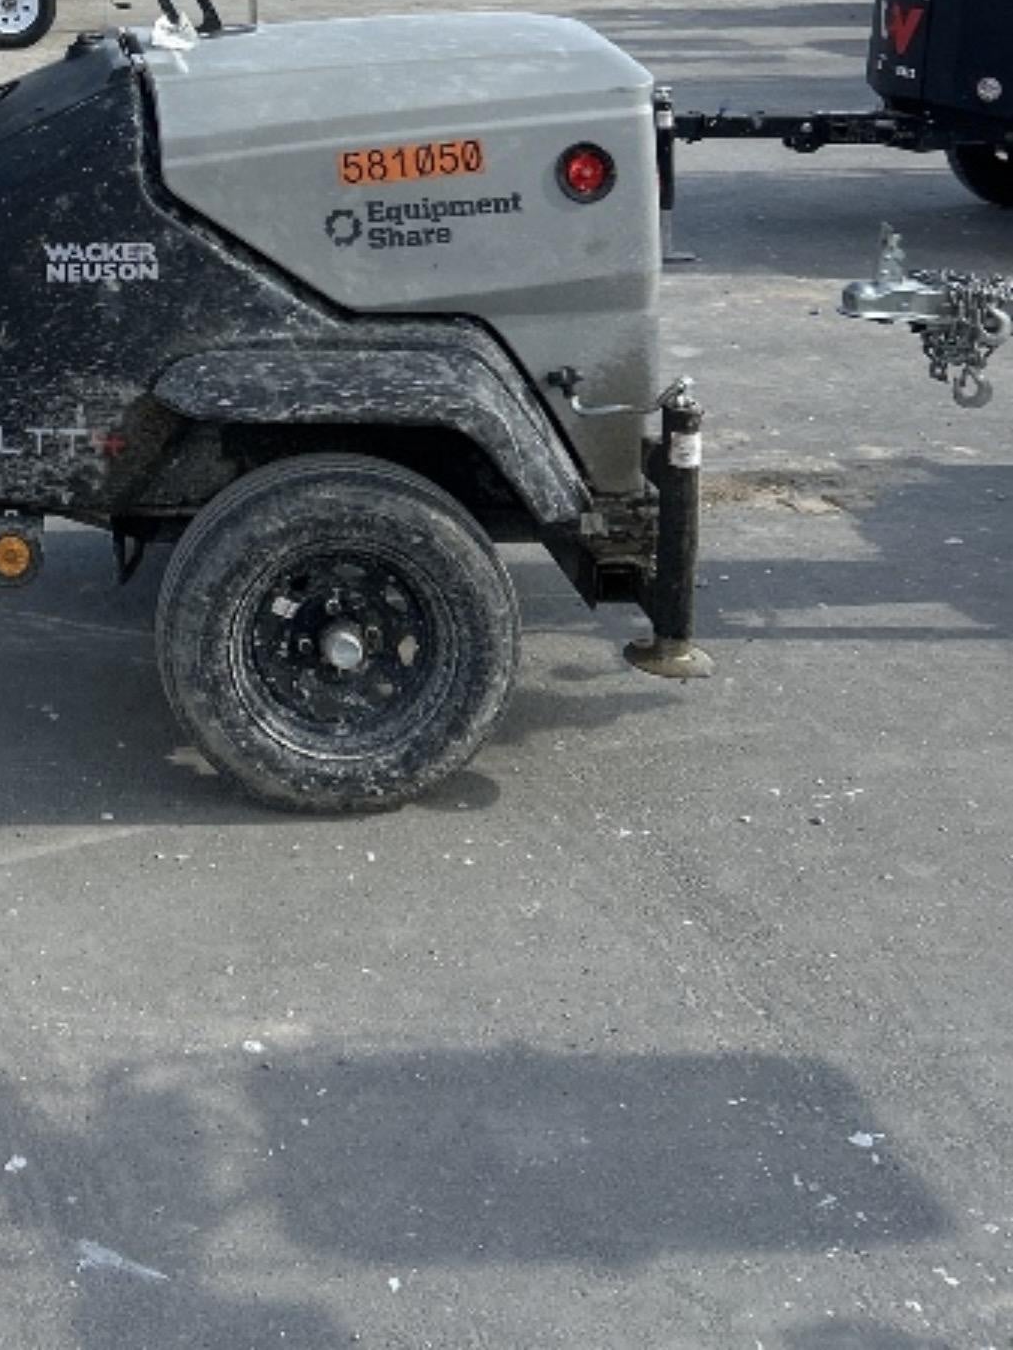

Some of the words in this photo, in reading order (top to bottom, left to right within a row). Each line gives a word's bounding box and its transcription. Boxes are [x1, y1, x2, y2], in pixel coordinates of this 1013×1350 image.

[342, 139, 484, 184] 581050
[366, 191, 523, 225] Equipment
[367, 227, 452, 250] Share
[44, 241, 158, 262] WACKER
[45, 262, 159, 284] NEUSON
